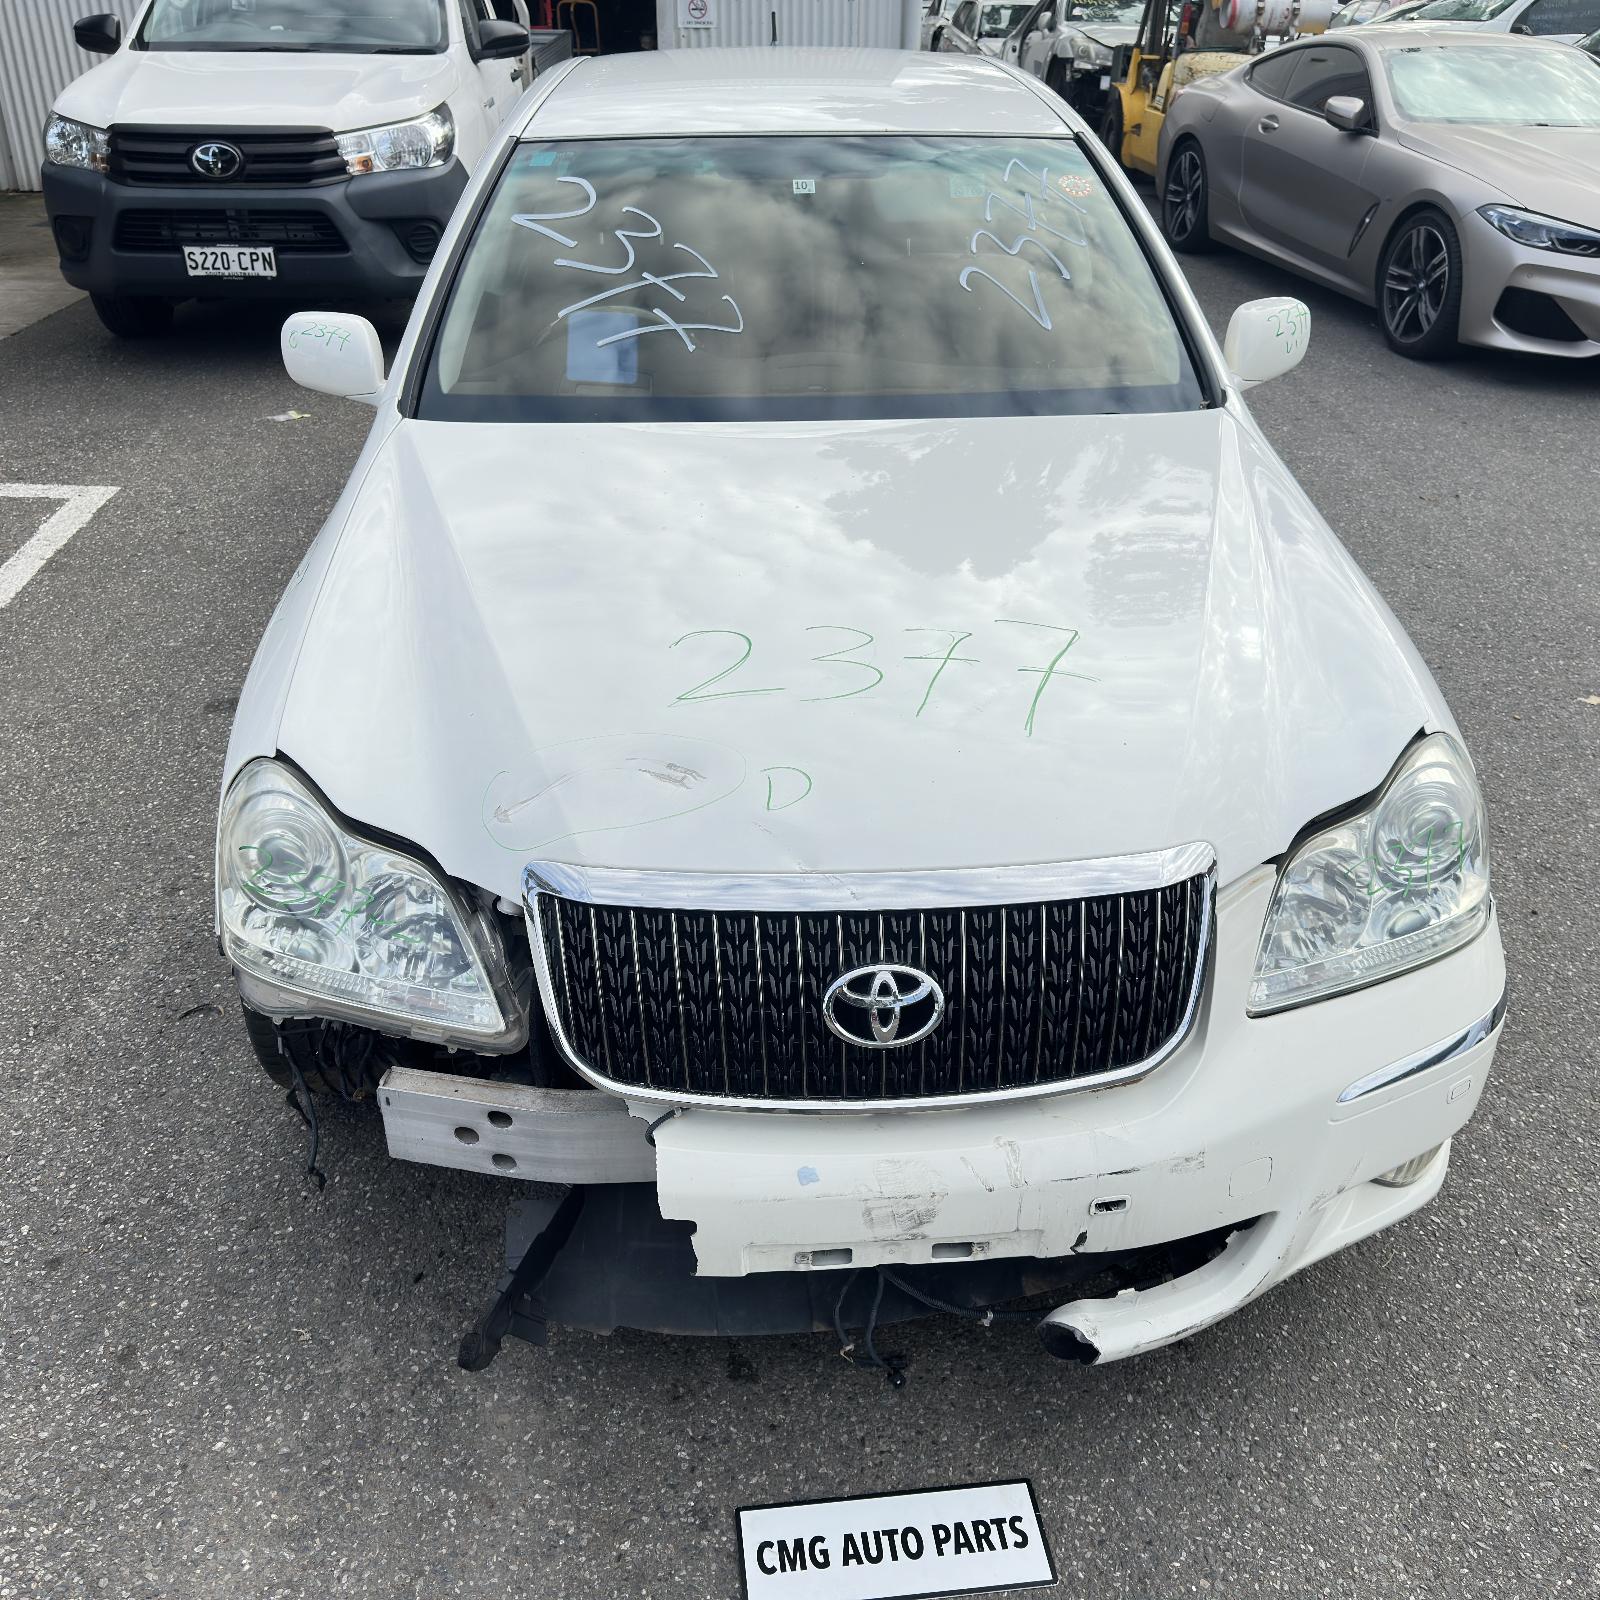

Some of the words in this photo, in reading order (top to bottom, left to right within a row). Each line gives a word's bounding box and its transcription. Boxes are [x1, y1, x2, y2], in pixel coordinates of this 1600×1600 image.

[511, 176, 744, 352] 2377
[959, 158, 1087, 331] 2377
[301, 321, 351, 351] 2377
[668, 620, 1102, 737] 2377
[761, 766, 812, 811] D
[756, 1535, 831, 1576] CMG
[842, 1526, 924, 1567] AUTO
[931, 1515, 1029, 1557] PARTS
